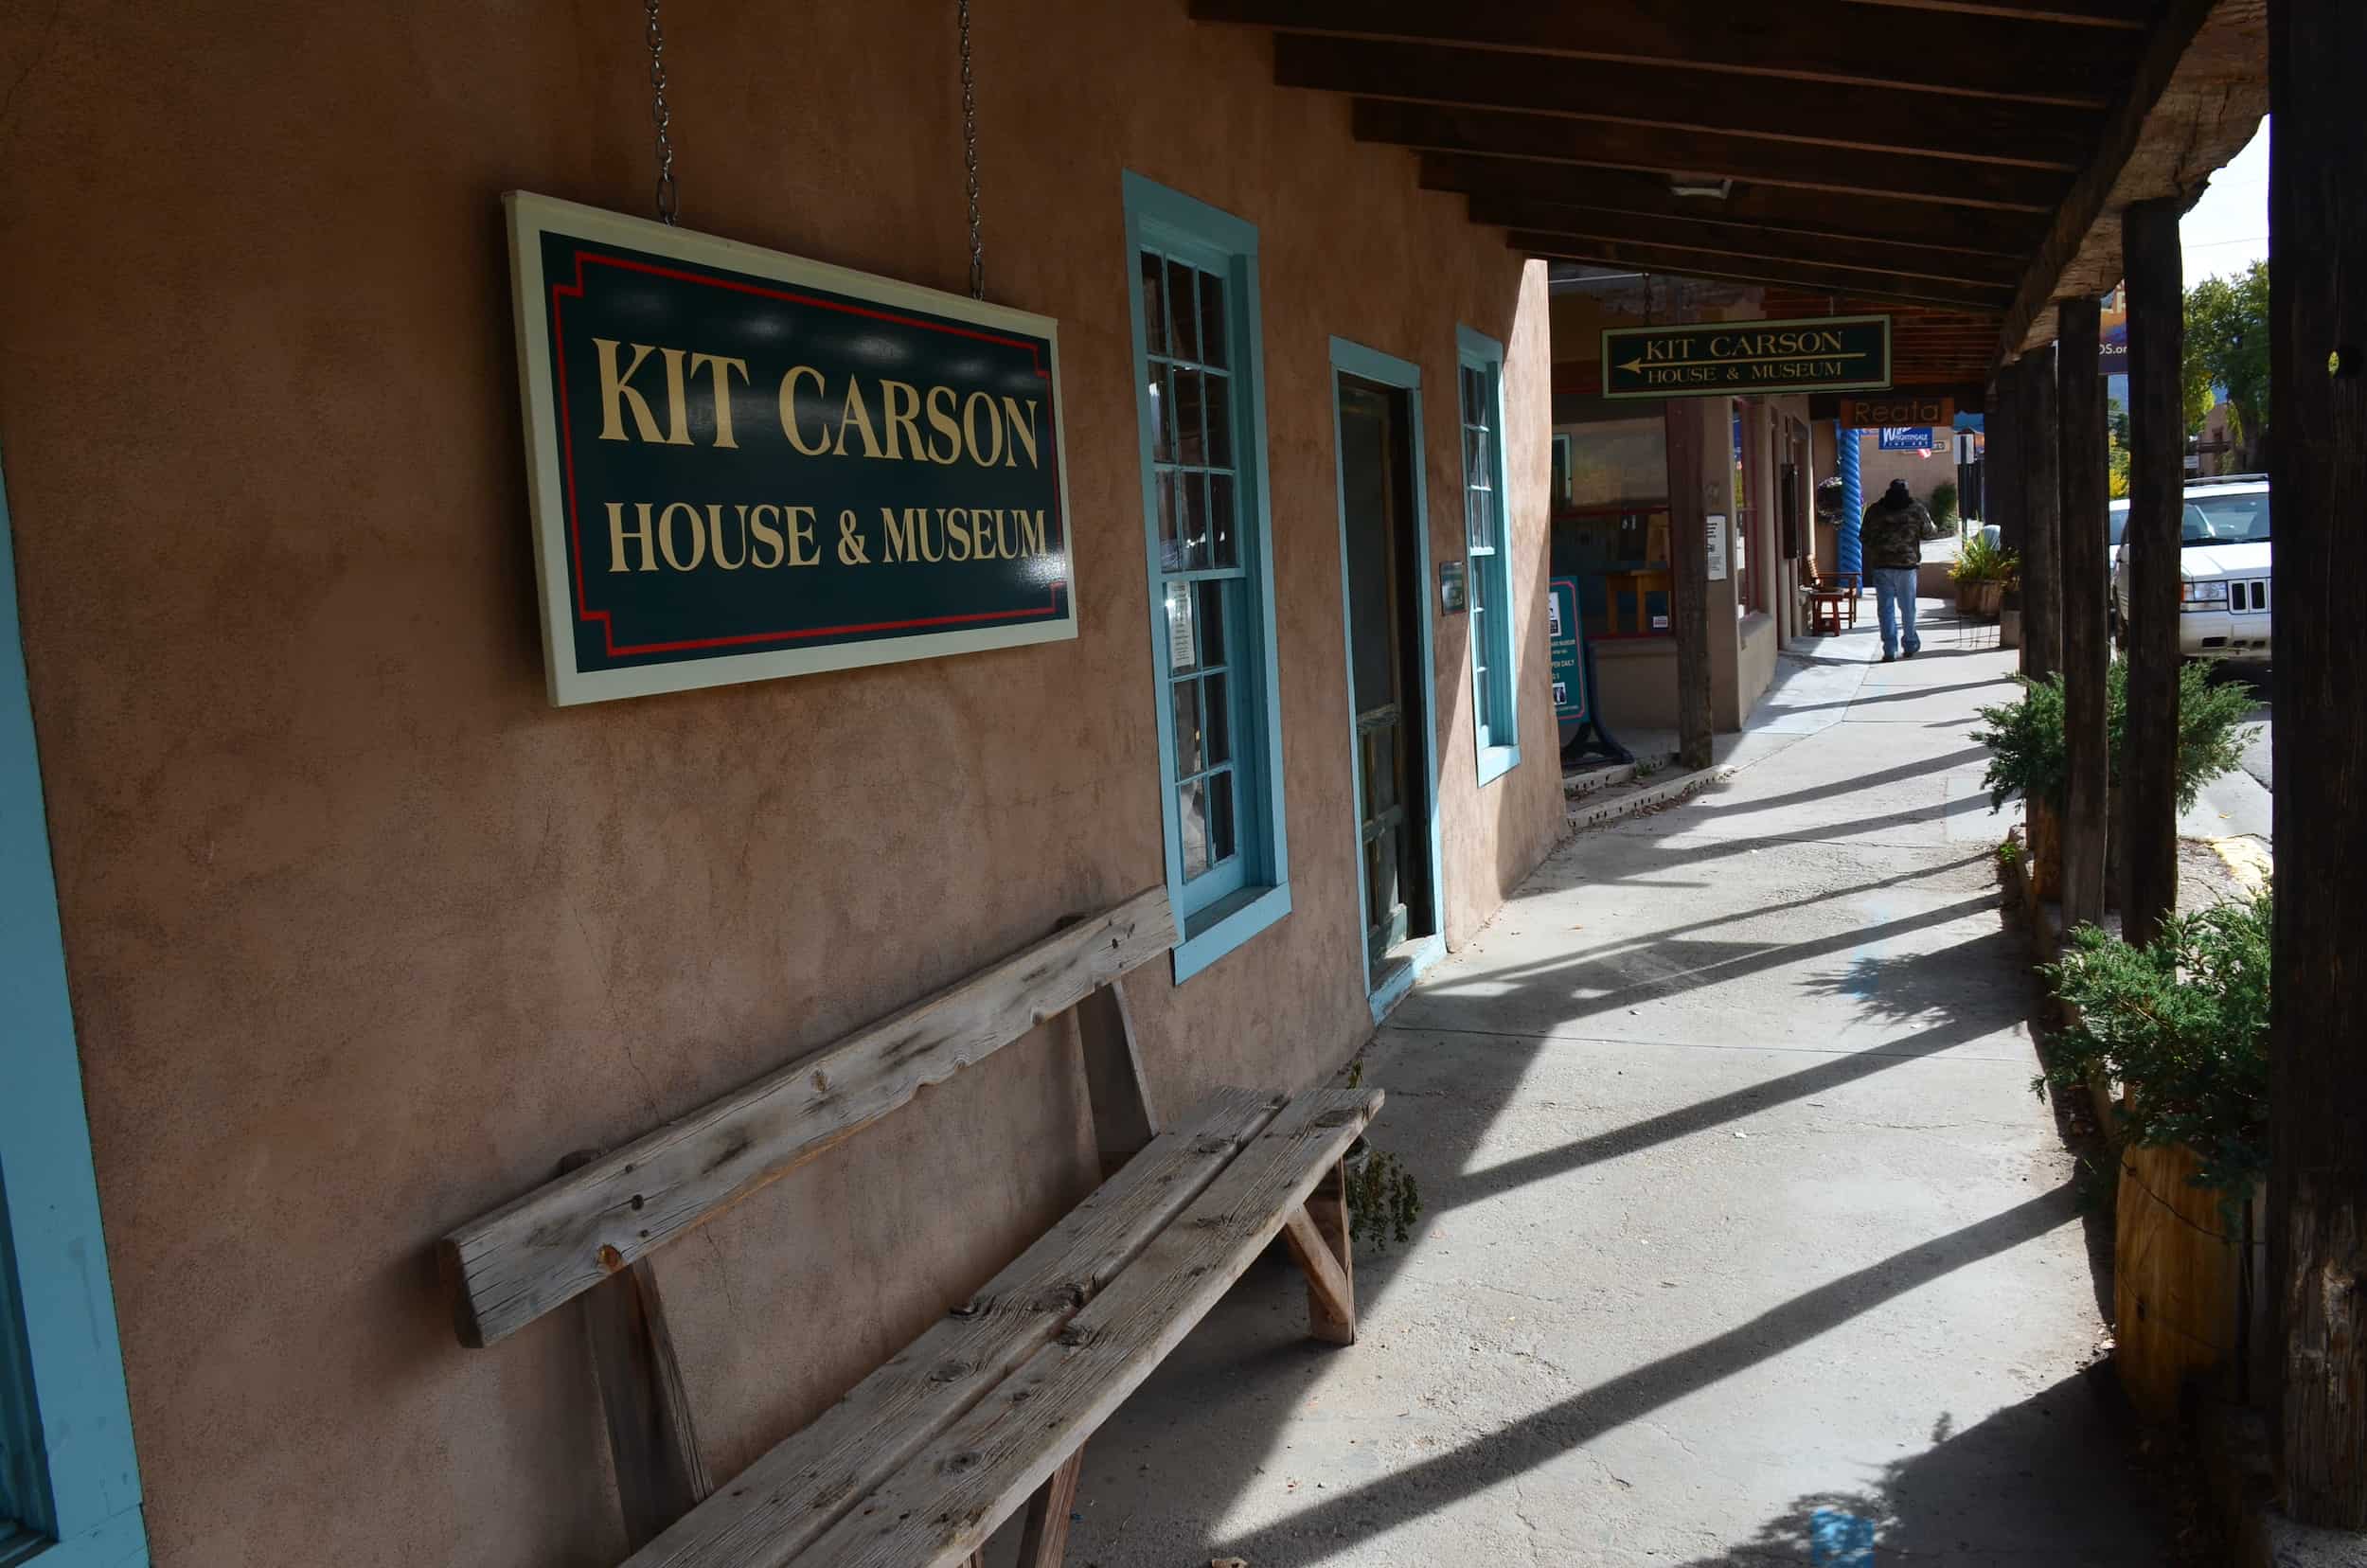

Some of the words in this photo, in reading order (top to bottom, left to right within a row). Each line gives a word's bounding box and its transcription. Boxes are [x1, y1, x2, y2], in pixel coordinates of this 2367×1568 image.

[1646, 338, 1696, 361] KIT
[1710, 331, 1843, 357] CARSON
[1648, 366, 1717, 383] HOUSE
[1726, 365, 1740, 380] &
[1752, 362, 1842, 379] MUSEUM
[593, 337, 750, 449] KIT
[777, 366, 1039, 470] CARSON
[1855, 401, 1940, 423] Reata
[604, 503, 821, 573] HOUSE
[837, 509, 871, 565] &
[881, 508, 1047, 562] MUSEUM
